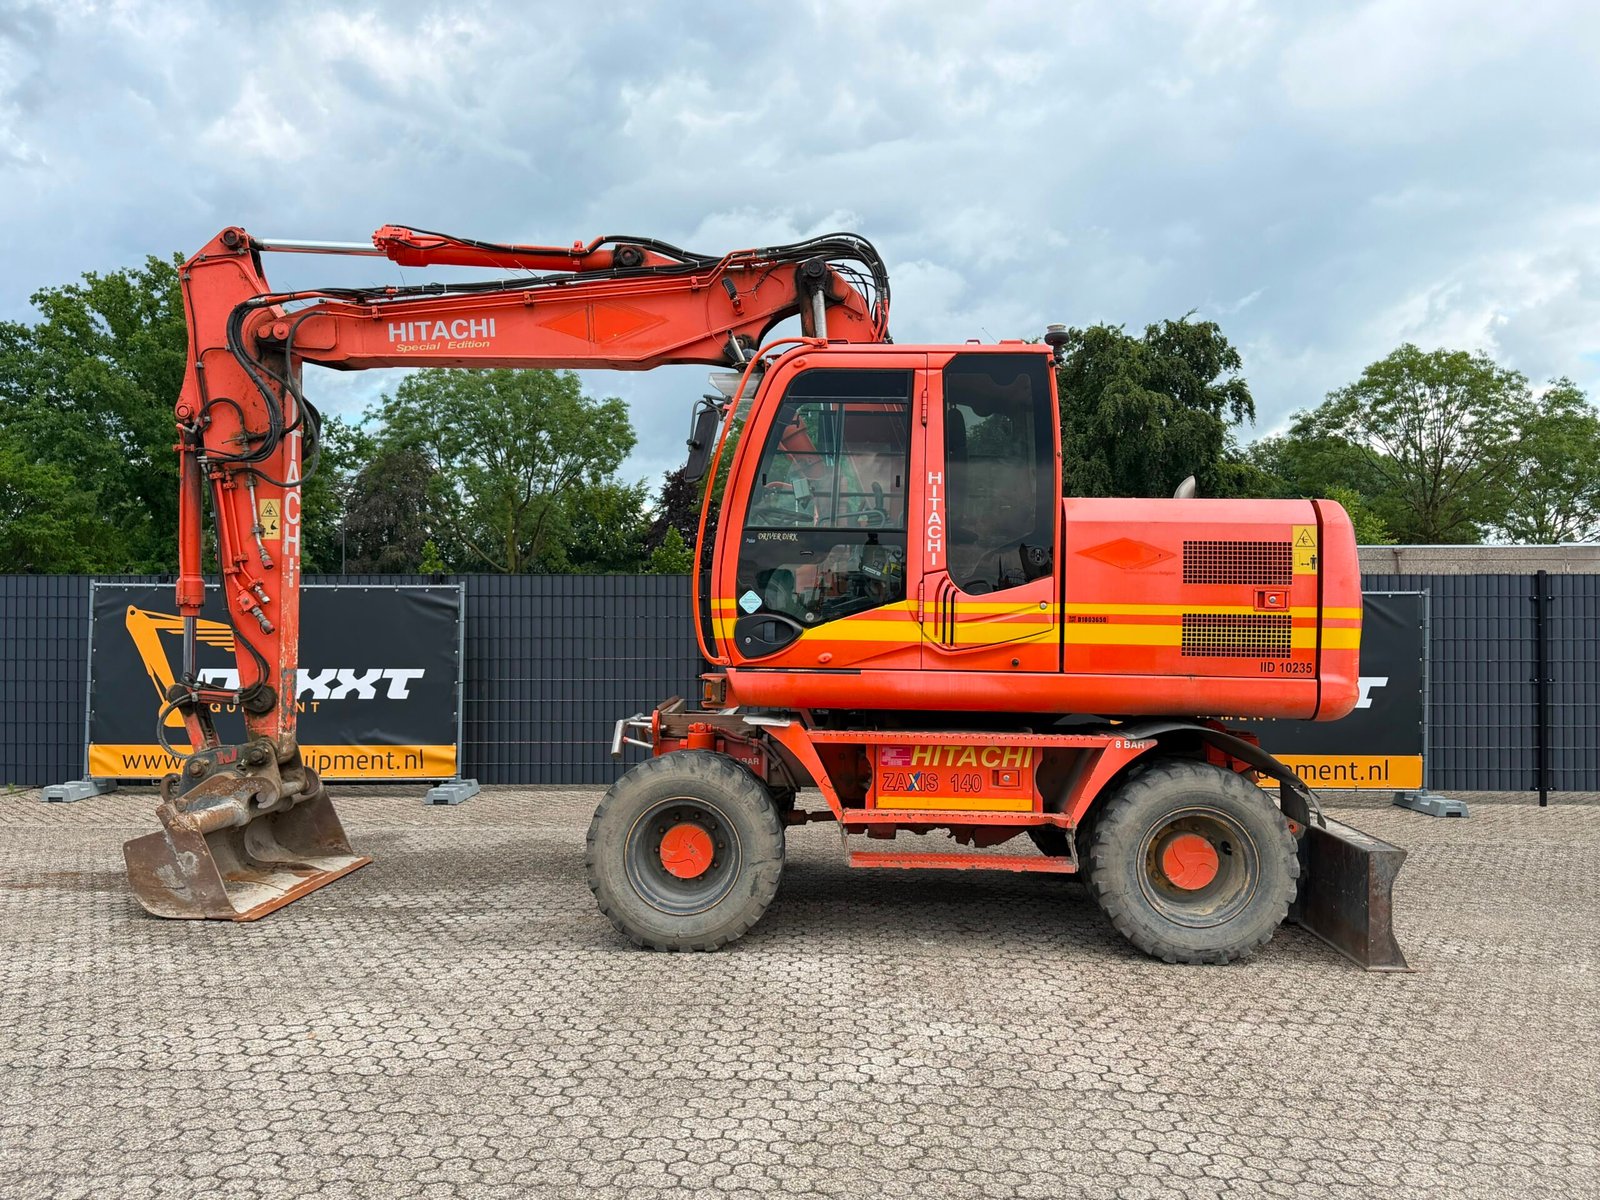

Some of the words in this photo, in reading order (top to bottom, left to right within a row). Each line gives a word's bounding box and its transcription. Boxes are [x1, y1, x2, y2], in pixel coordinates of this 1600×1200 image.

[388, 318, 496, 342] HITACHI
[396, 342, 441, 353] Special
[447, 340, 490, 350] Edition
[927, 471, 942, 566] HITACHI
[1260, 661, 1275, 673] IID
[1279, 662, 1313, 674] 10235
[195, 668, 426, 700] DXXT
[1115, 740, 1121, 749] 8
[1123, 740, 1145, 749] BAR
[911, 745, 1033, 768] HITACHI
[882, 771, 939, 792] ZAXIS
[950, 773, 983, 793] 140
